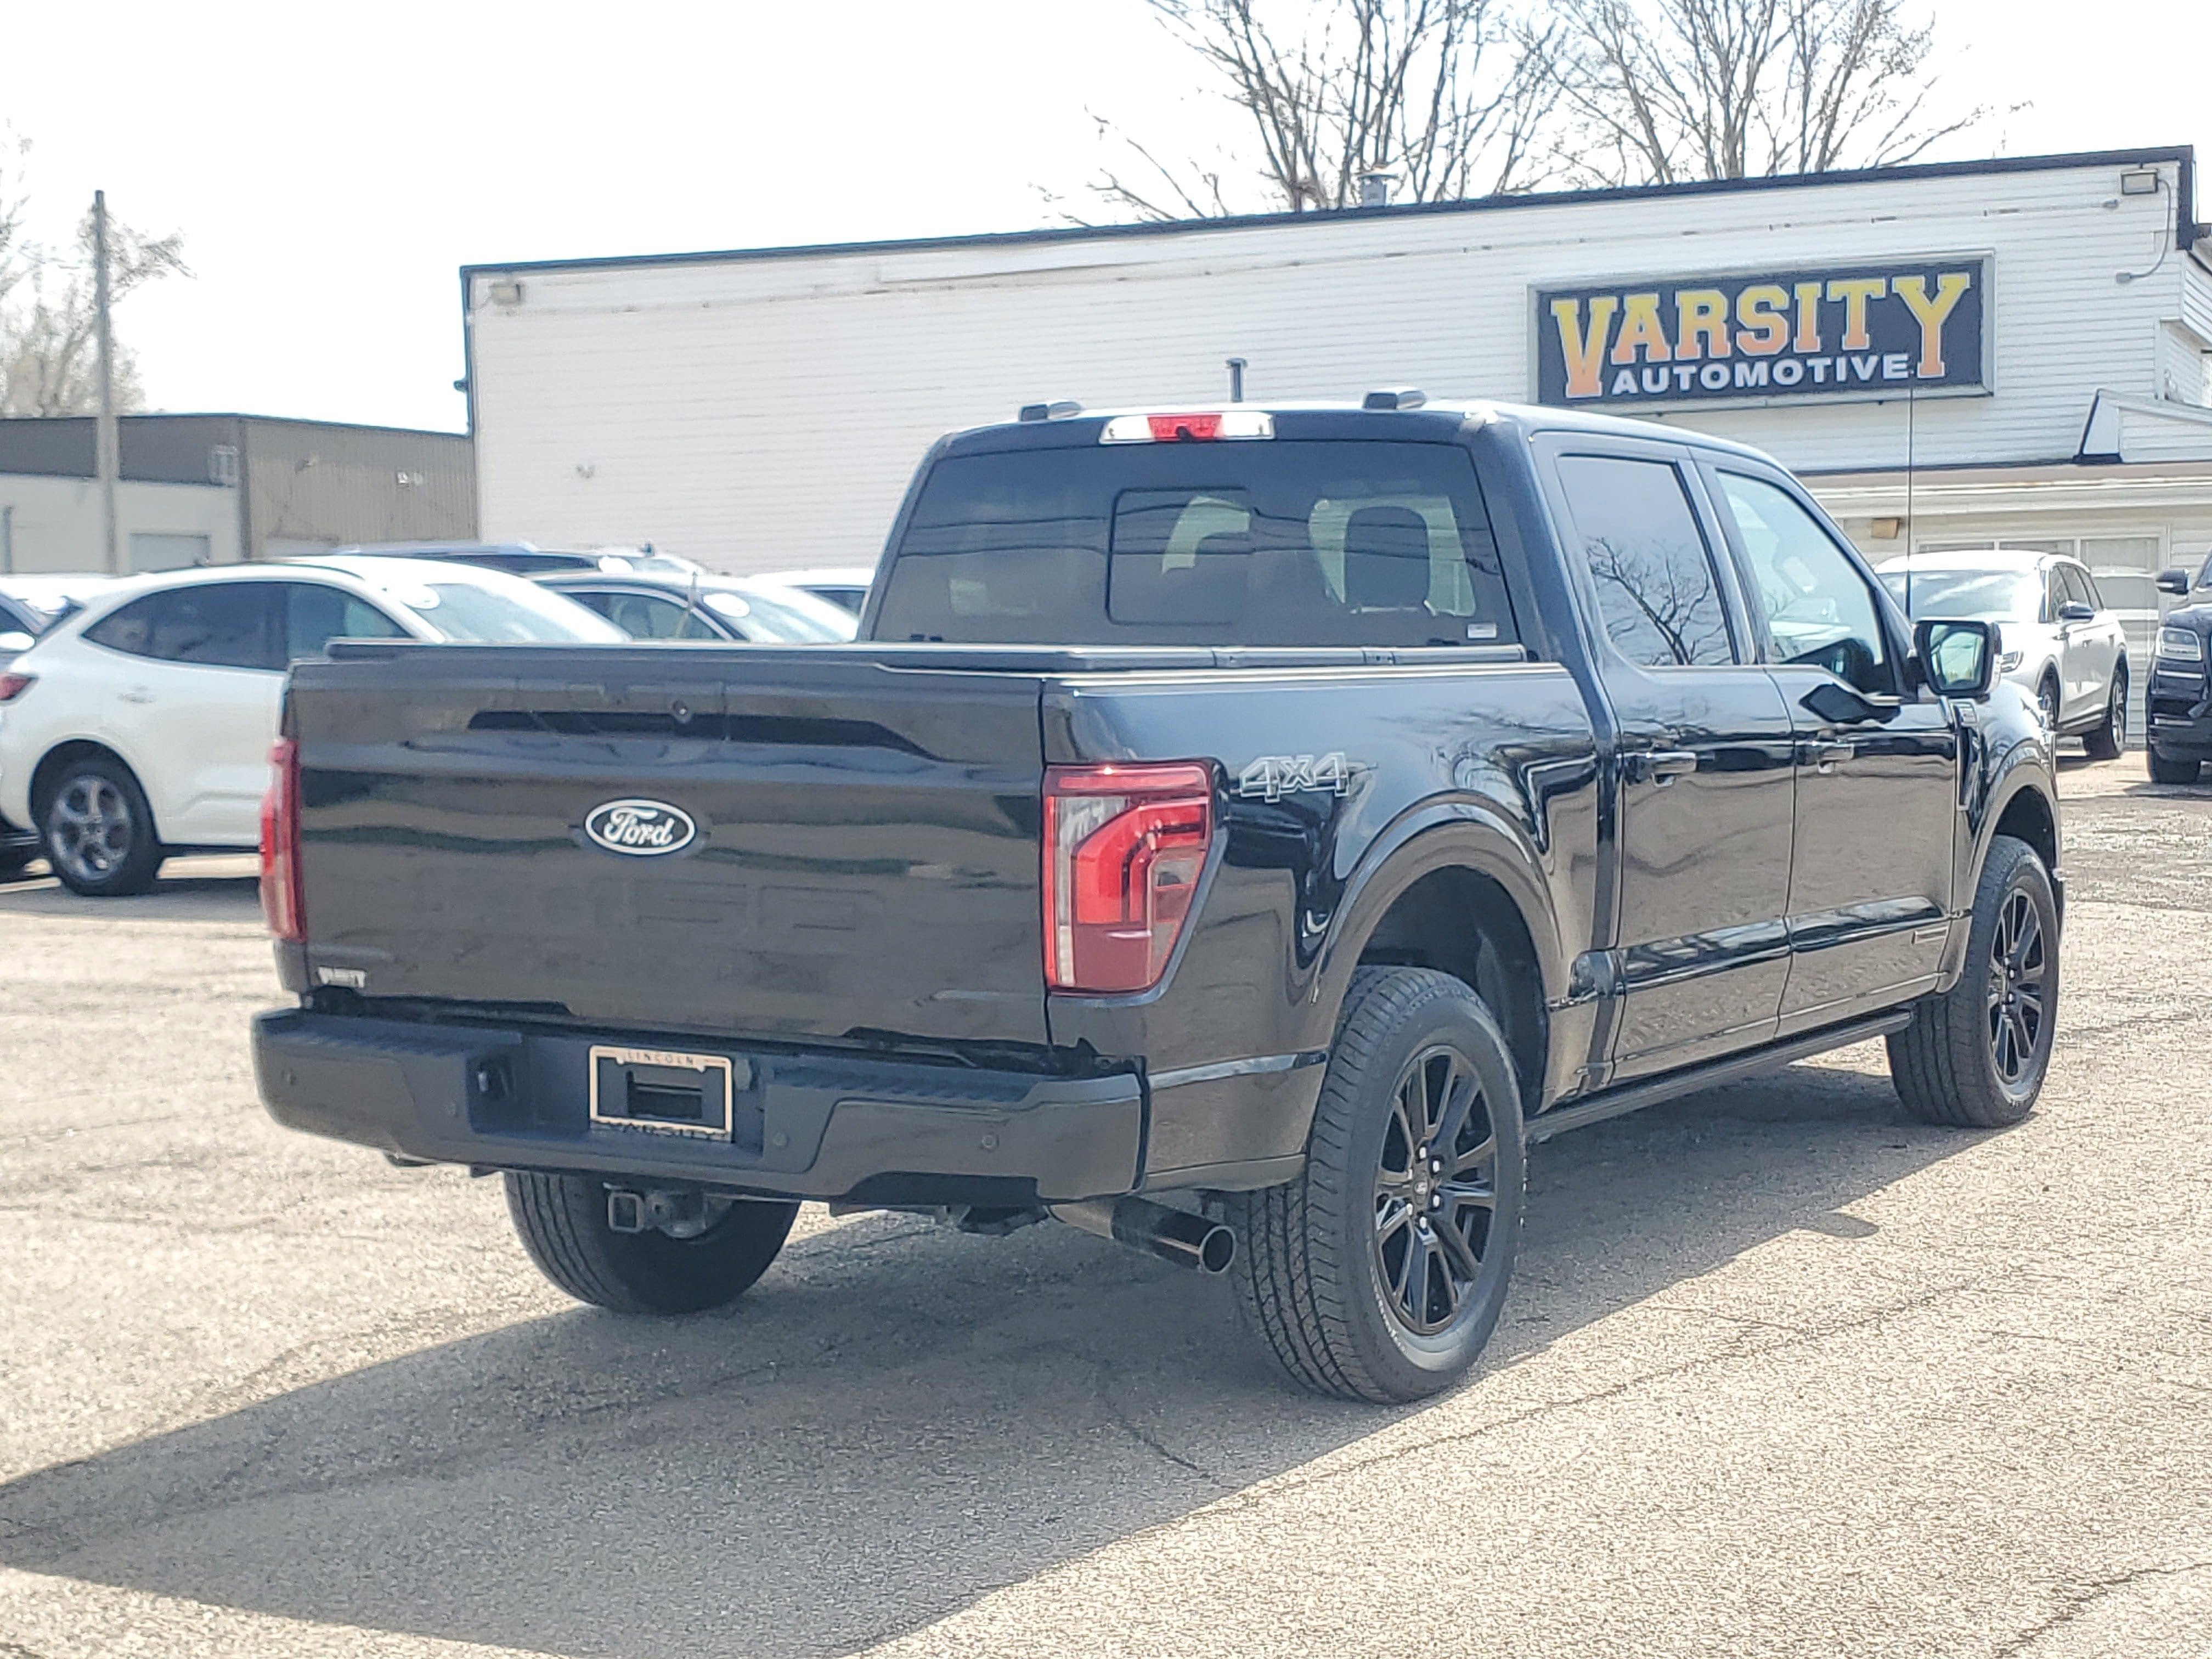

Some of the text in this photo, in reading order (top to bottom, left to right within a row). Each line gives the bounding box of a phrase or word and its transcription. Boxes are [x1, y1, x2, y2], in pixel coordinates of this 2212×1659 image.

[1550, 273, 1971, 398] VARSITY
[1610, 353, 1911, 396] AUTOMOTIVE
[603, 806, 675, 845] Ford
[627, 1051, 695, 1065] LINCOLN
